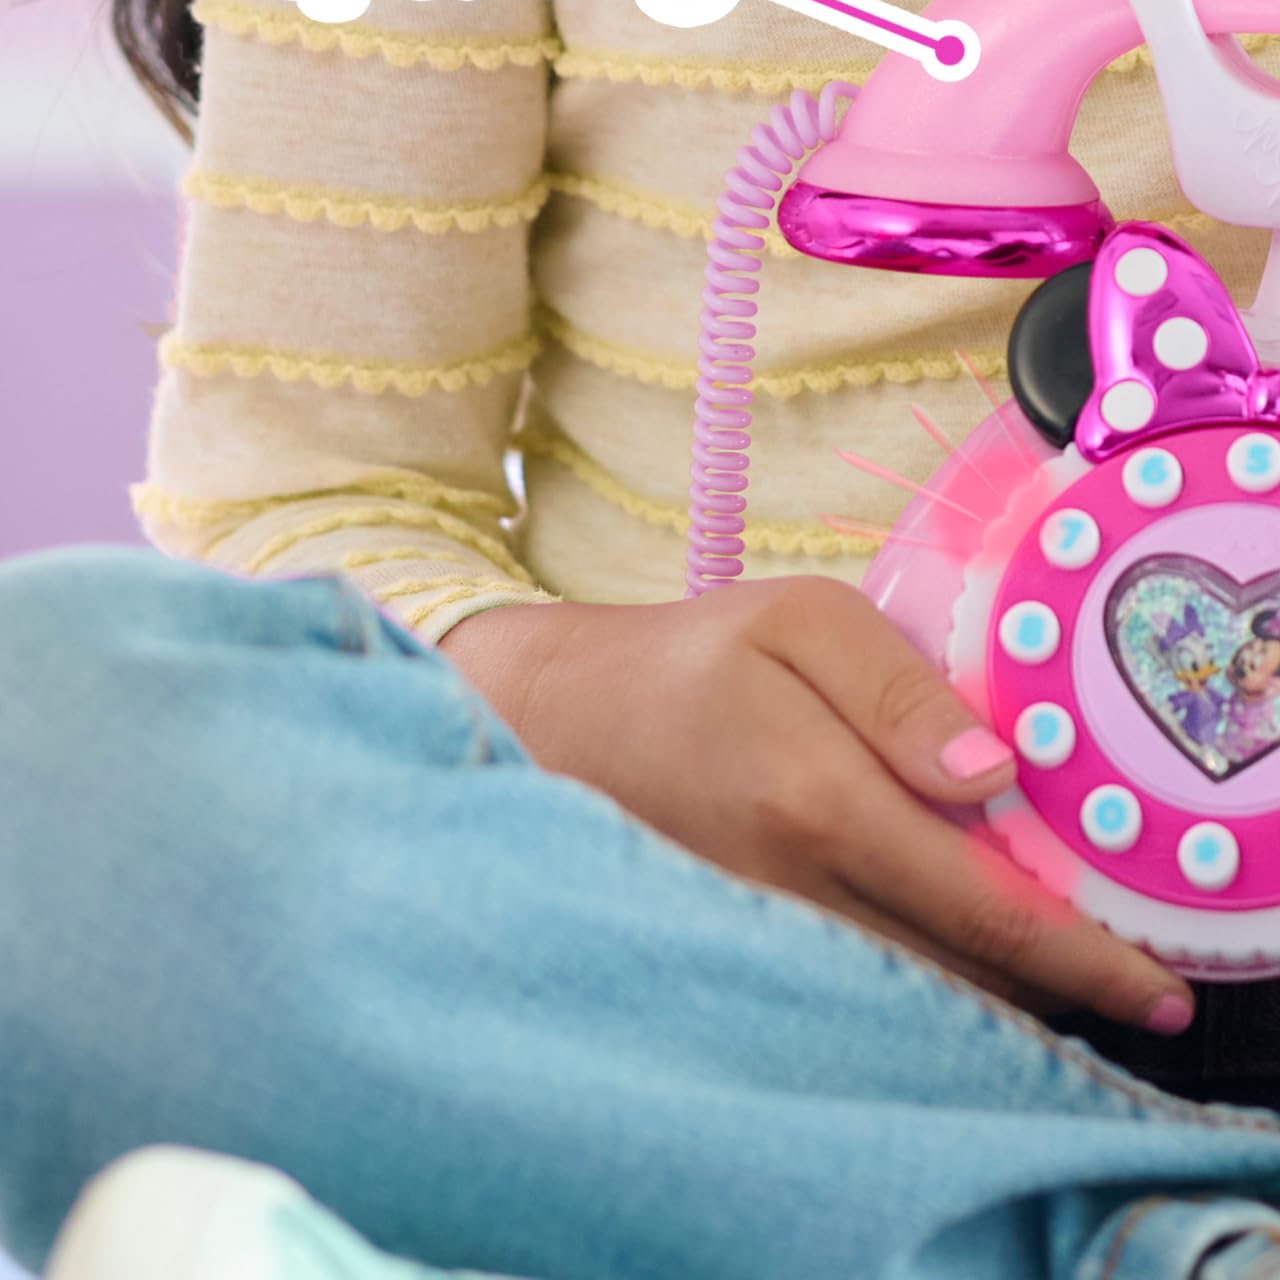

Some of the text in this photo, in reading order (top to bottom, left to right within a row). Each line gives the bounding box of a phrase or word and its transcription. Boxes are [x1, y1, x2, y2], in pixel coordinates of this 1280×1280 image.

[1139, 457, 1168, 486] 6
[1243, 444, 1272, 476] 5
[1058, 517, 1086, 551] 7
[1031, 711, 1060, 748] 9
[1093, 795, 1128, 834] 0
